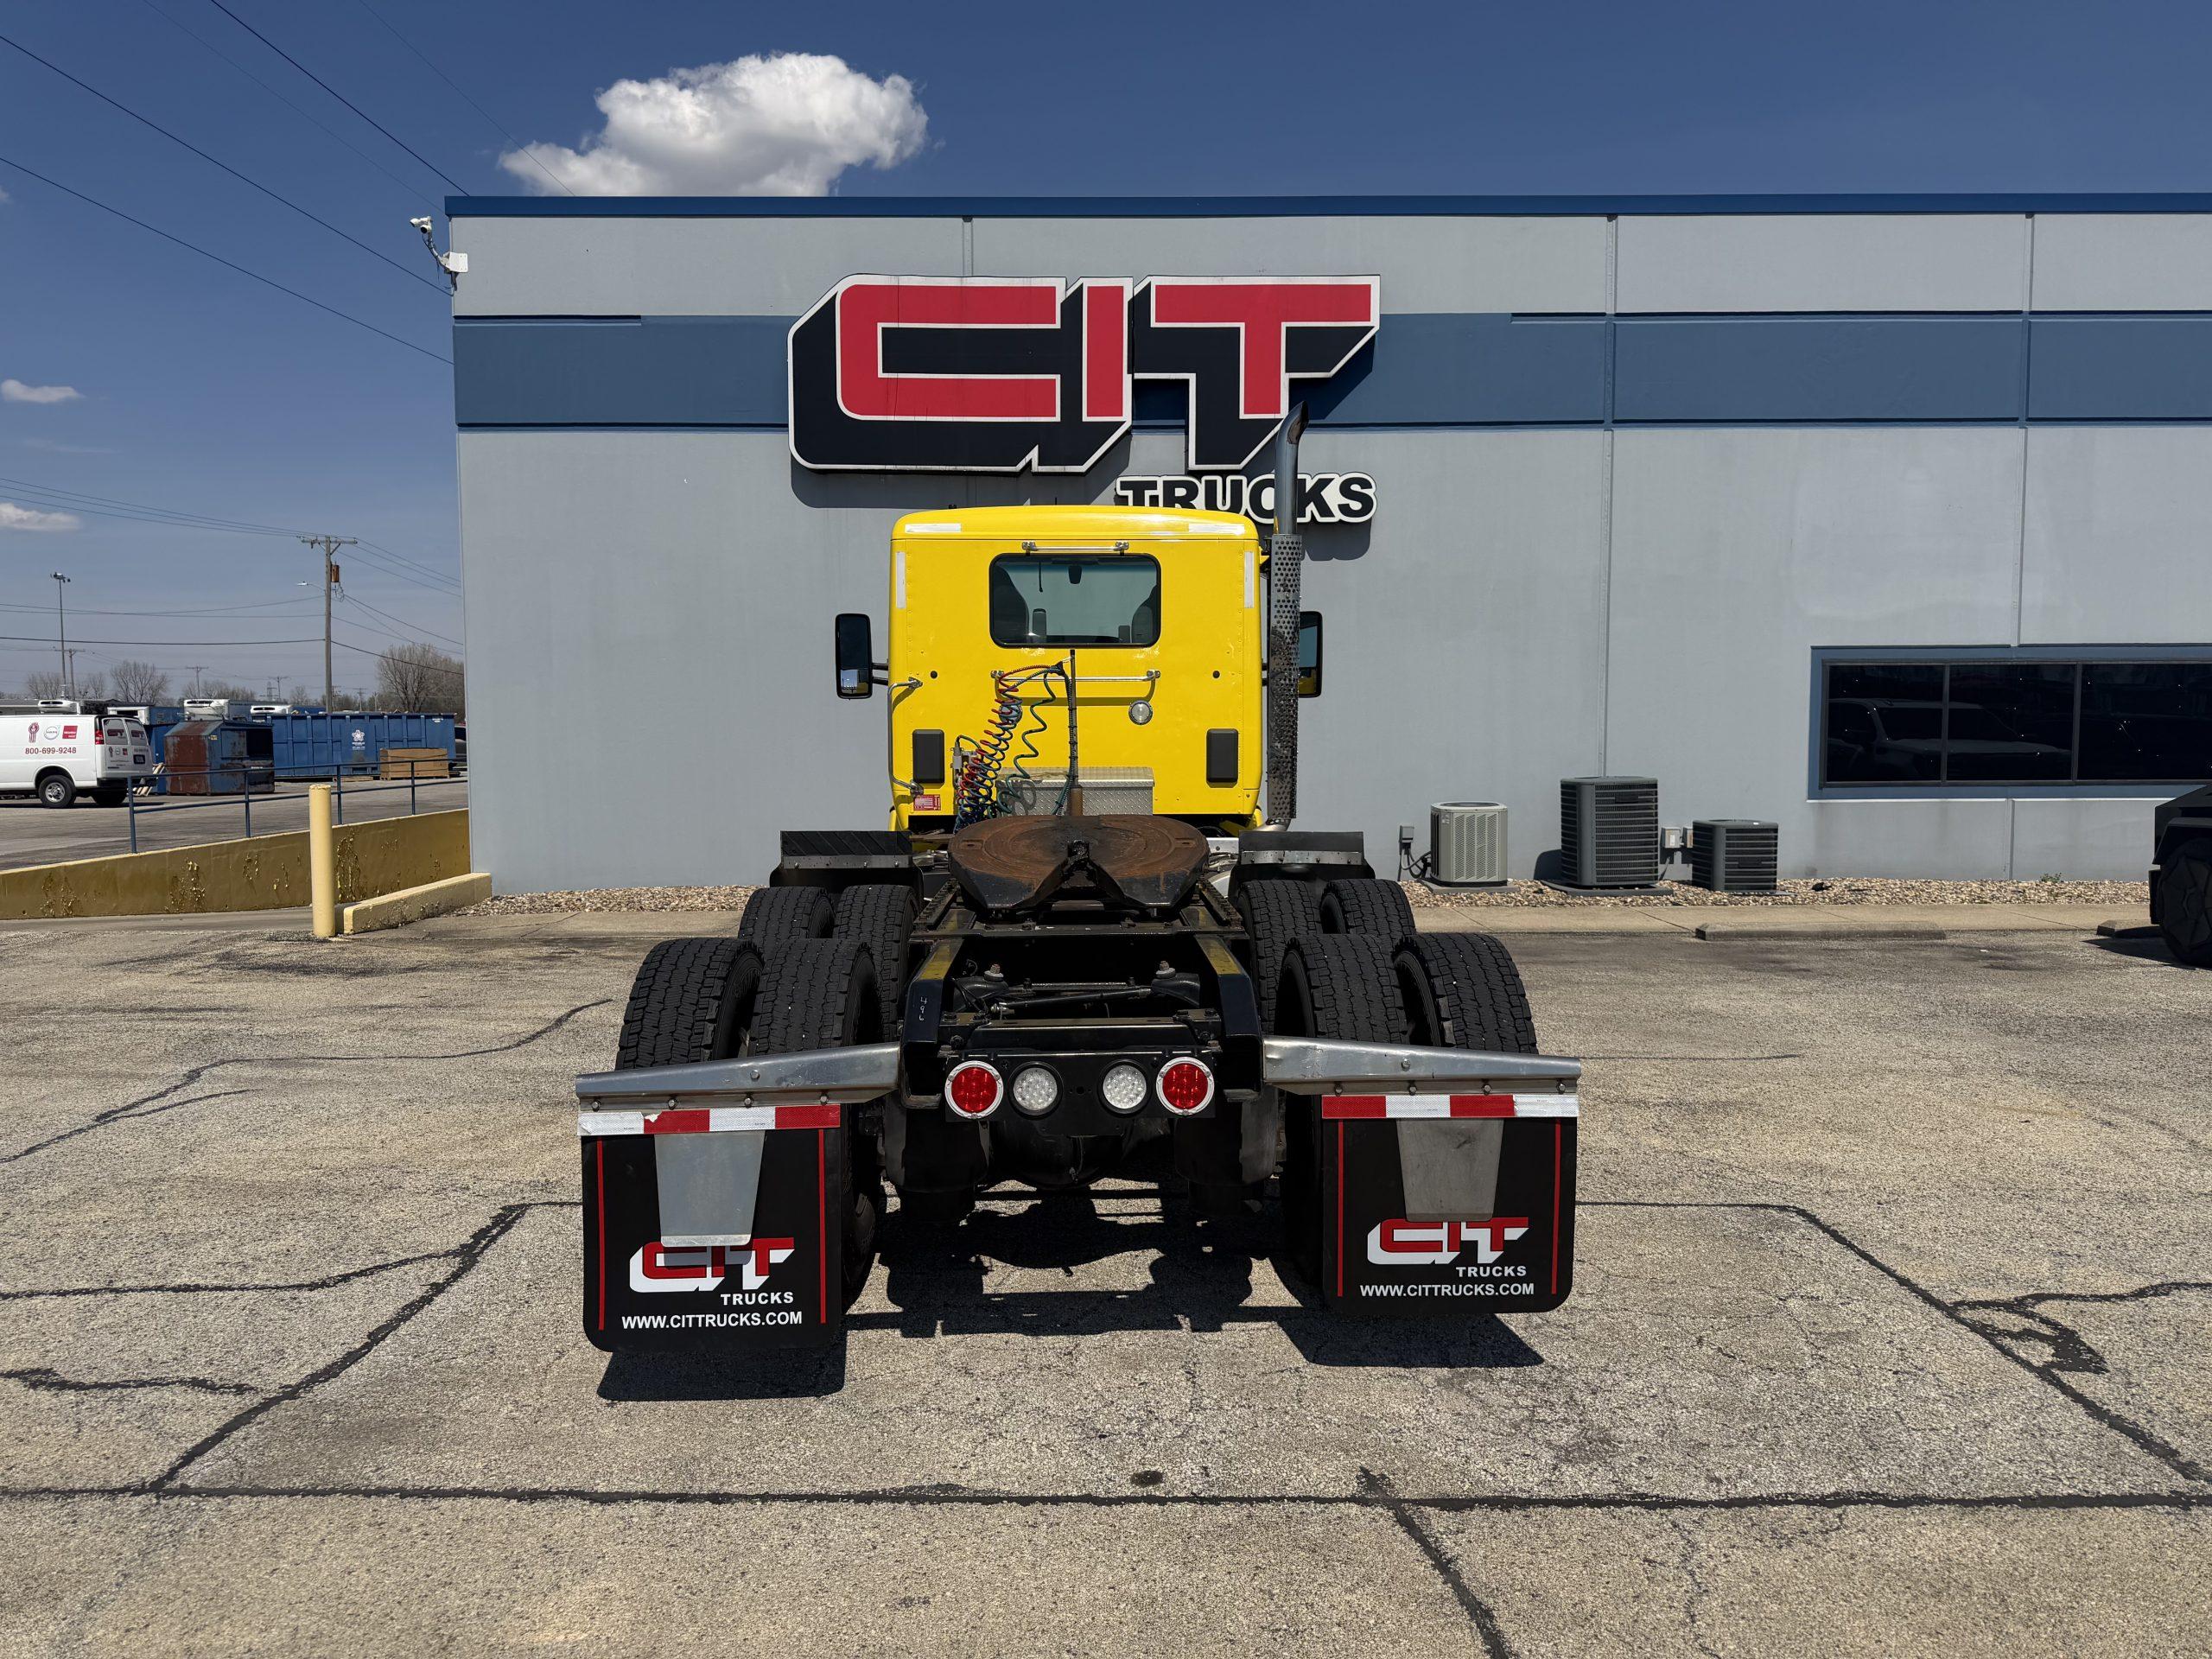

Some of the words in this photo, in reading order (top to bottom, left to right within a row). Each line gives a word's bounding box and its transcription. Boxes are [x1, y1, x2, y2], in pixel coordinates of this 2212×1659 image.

[788, 274, 1380, 473] CIT
[1116, 473, 1376, 523] TRUCKS
[1367, 1217, 1529, 1265] CIT
[630, 1237, 795, 1293] CIT
[1456, 1265, 1527, 1277] TRUCKS
[721, 1292, 794, 1306] TRUCKS
[1360, 1283, 1535, 1296] WWW.CITTRUCKS.COM
[622, 1311, 802, 1329] WWW.CITTRUCKS.COM
